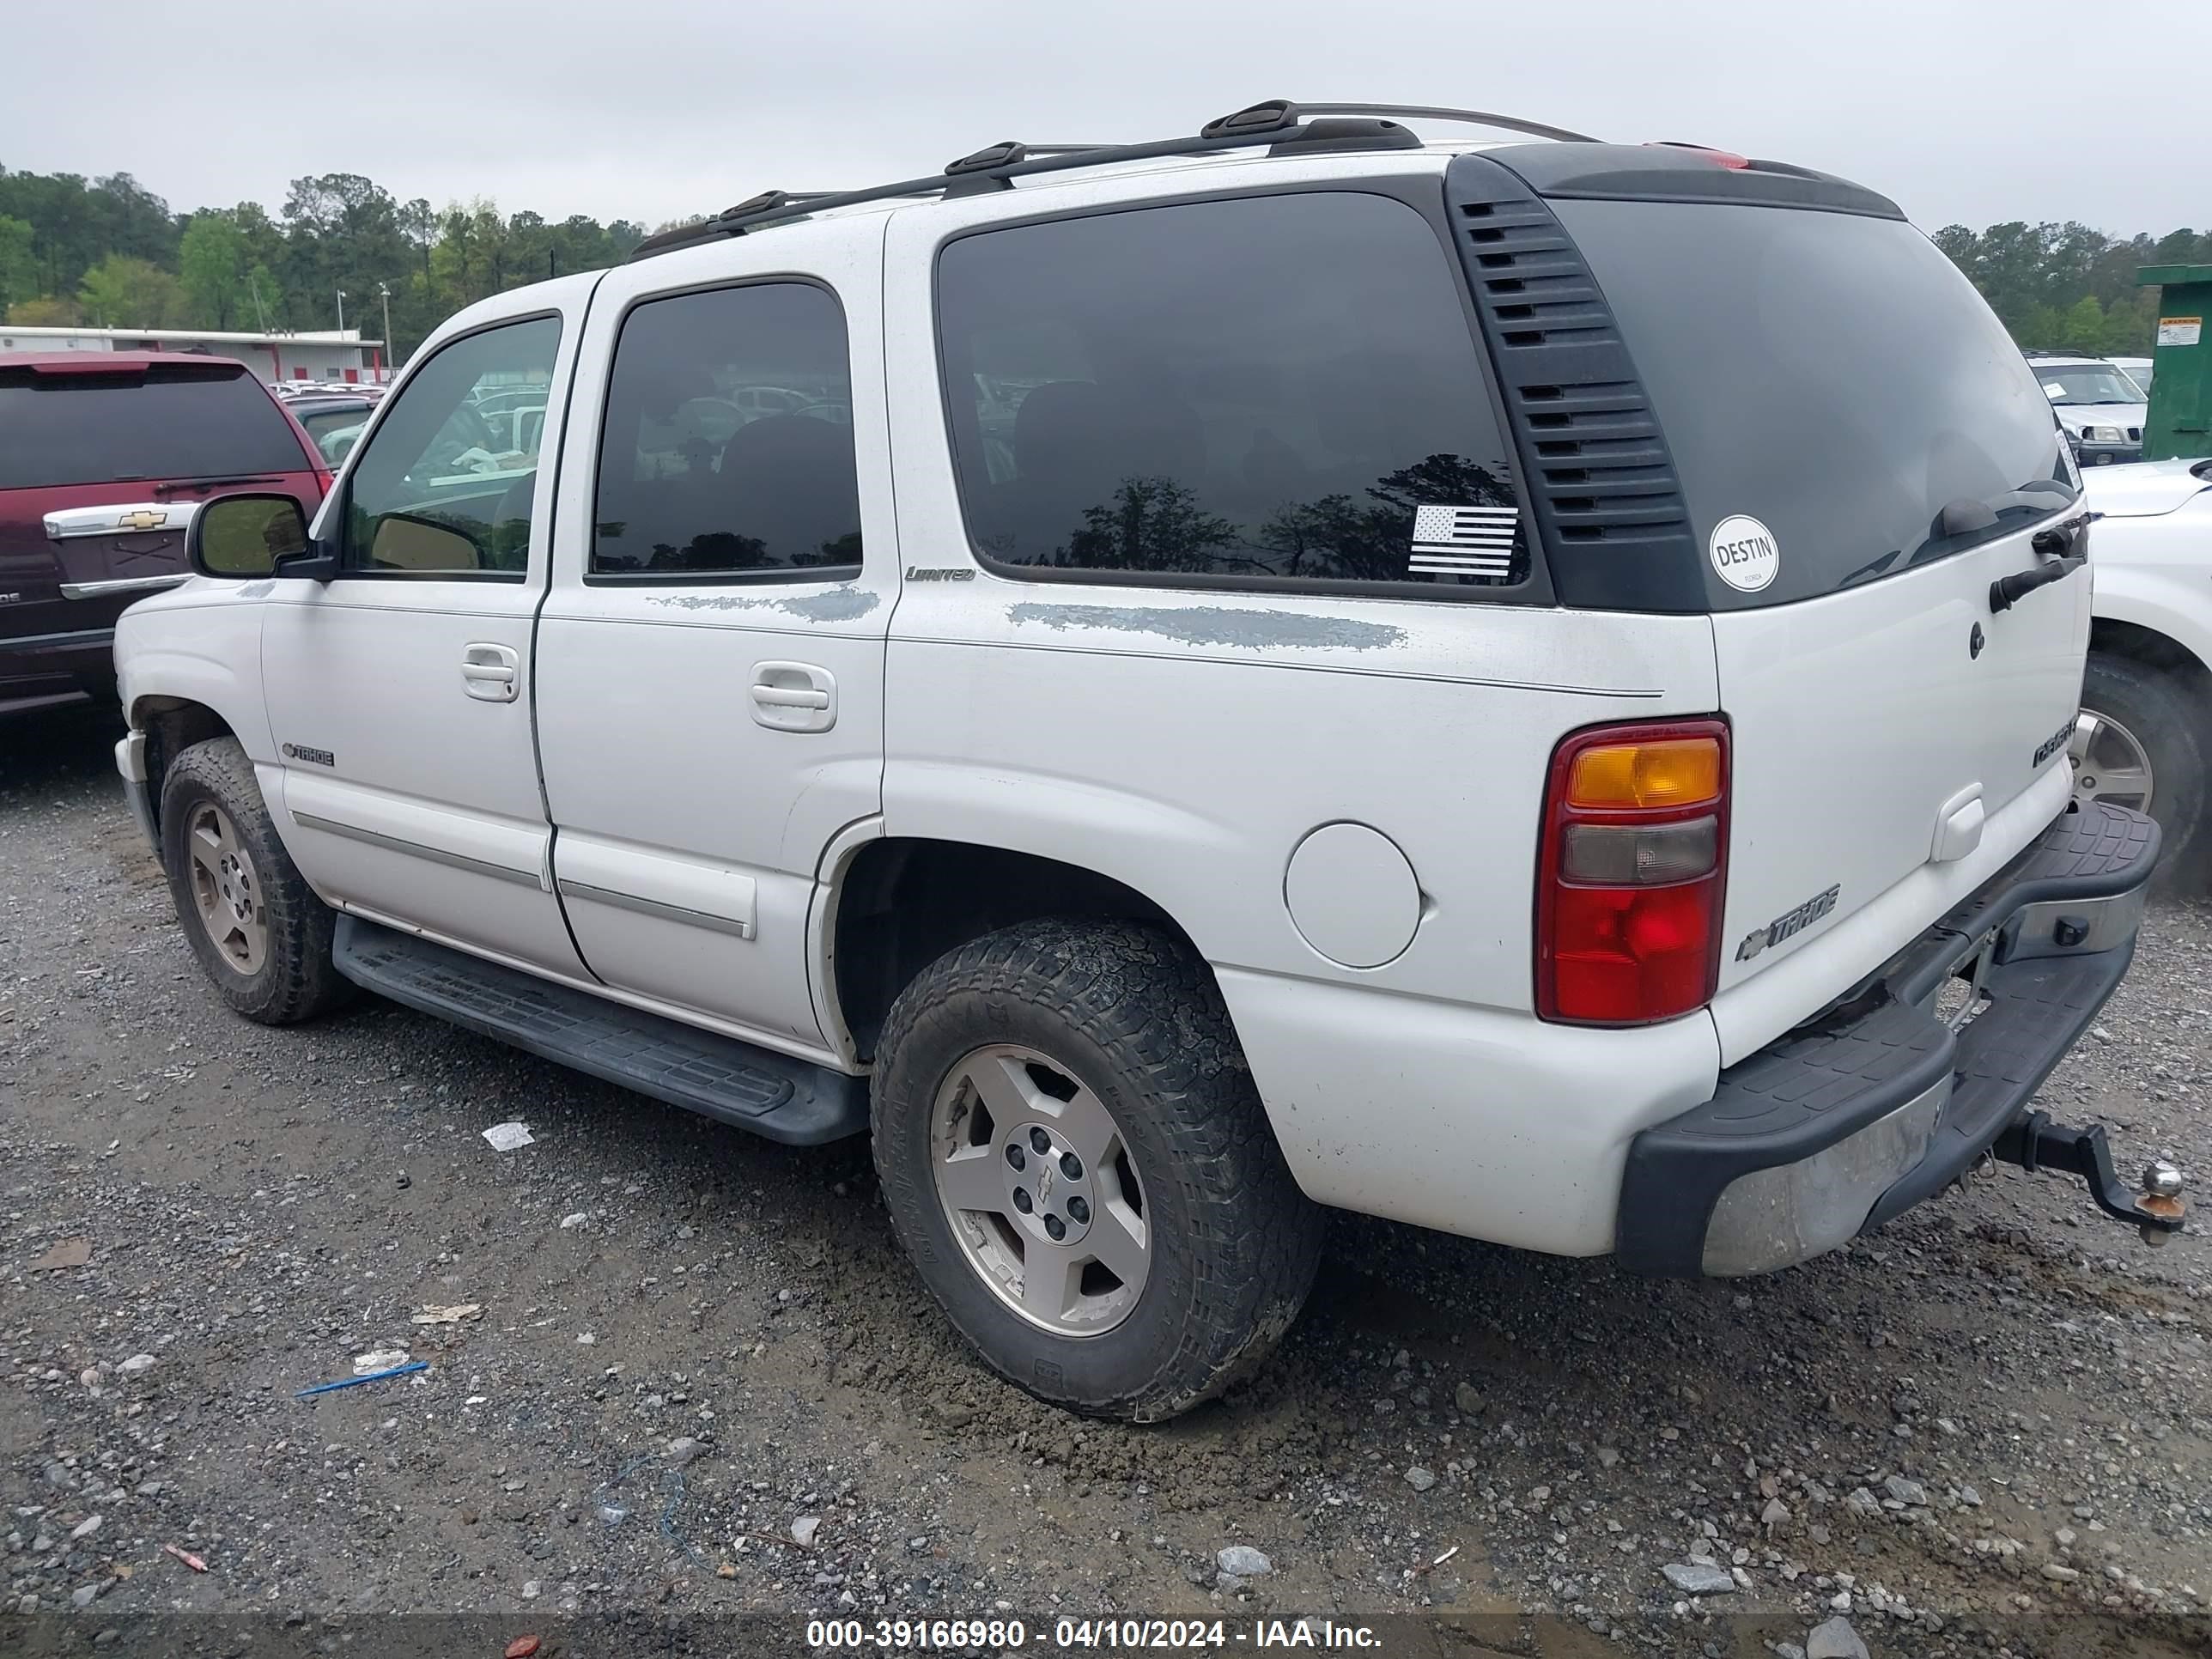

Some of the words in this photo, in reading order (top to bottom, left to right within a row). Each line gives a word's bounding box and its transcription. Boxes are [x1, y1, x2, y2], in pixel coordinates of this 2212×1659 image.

[1716, 536, 1772, 567] DESTIN
[294, 744, 335, 767] TAHOE
[1768, 883, 1840, 948] TAHOE
